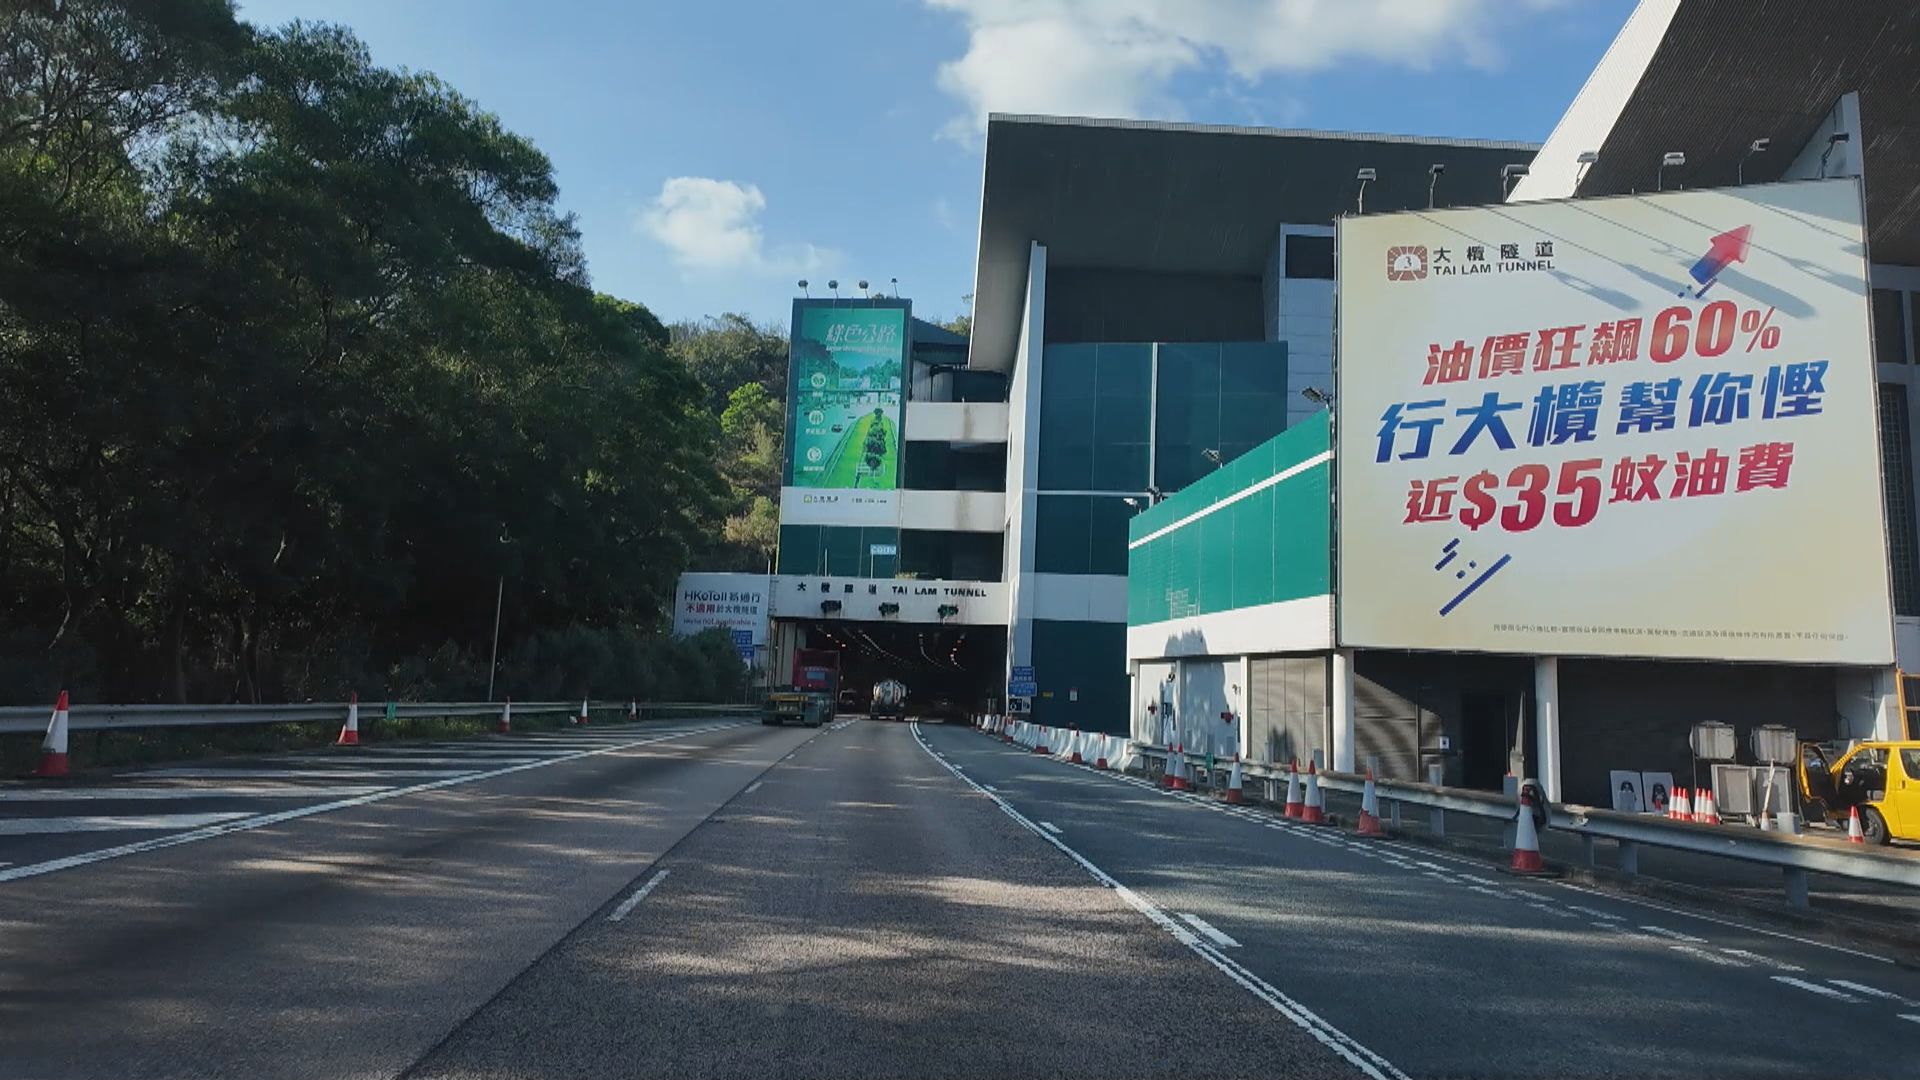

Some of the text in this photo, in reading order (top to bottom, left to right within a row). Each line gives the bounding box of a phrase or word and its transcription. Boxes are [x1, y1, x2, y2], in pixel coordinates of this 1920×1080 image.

[1433, 241, 1554, 263] 大欖隧道
[1433, 260, 1556, 276] TAI LAM TUNNEL
[892, 585, 908, 595] TAI
[914, 586, 937, 596] LAM
[943, 587, 987, 598] TUNNEL
